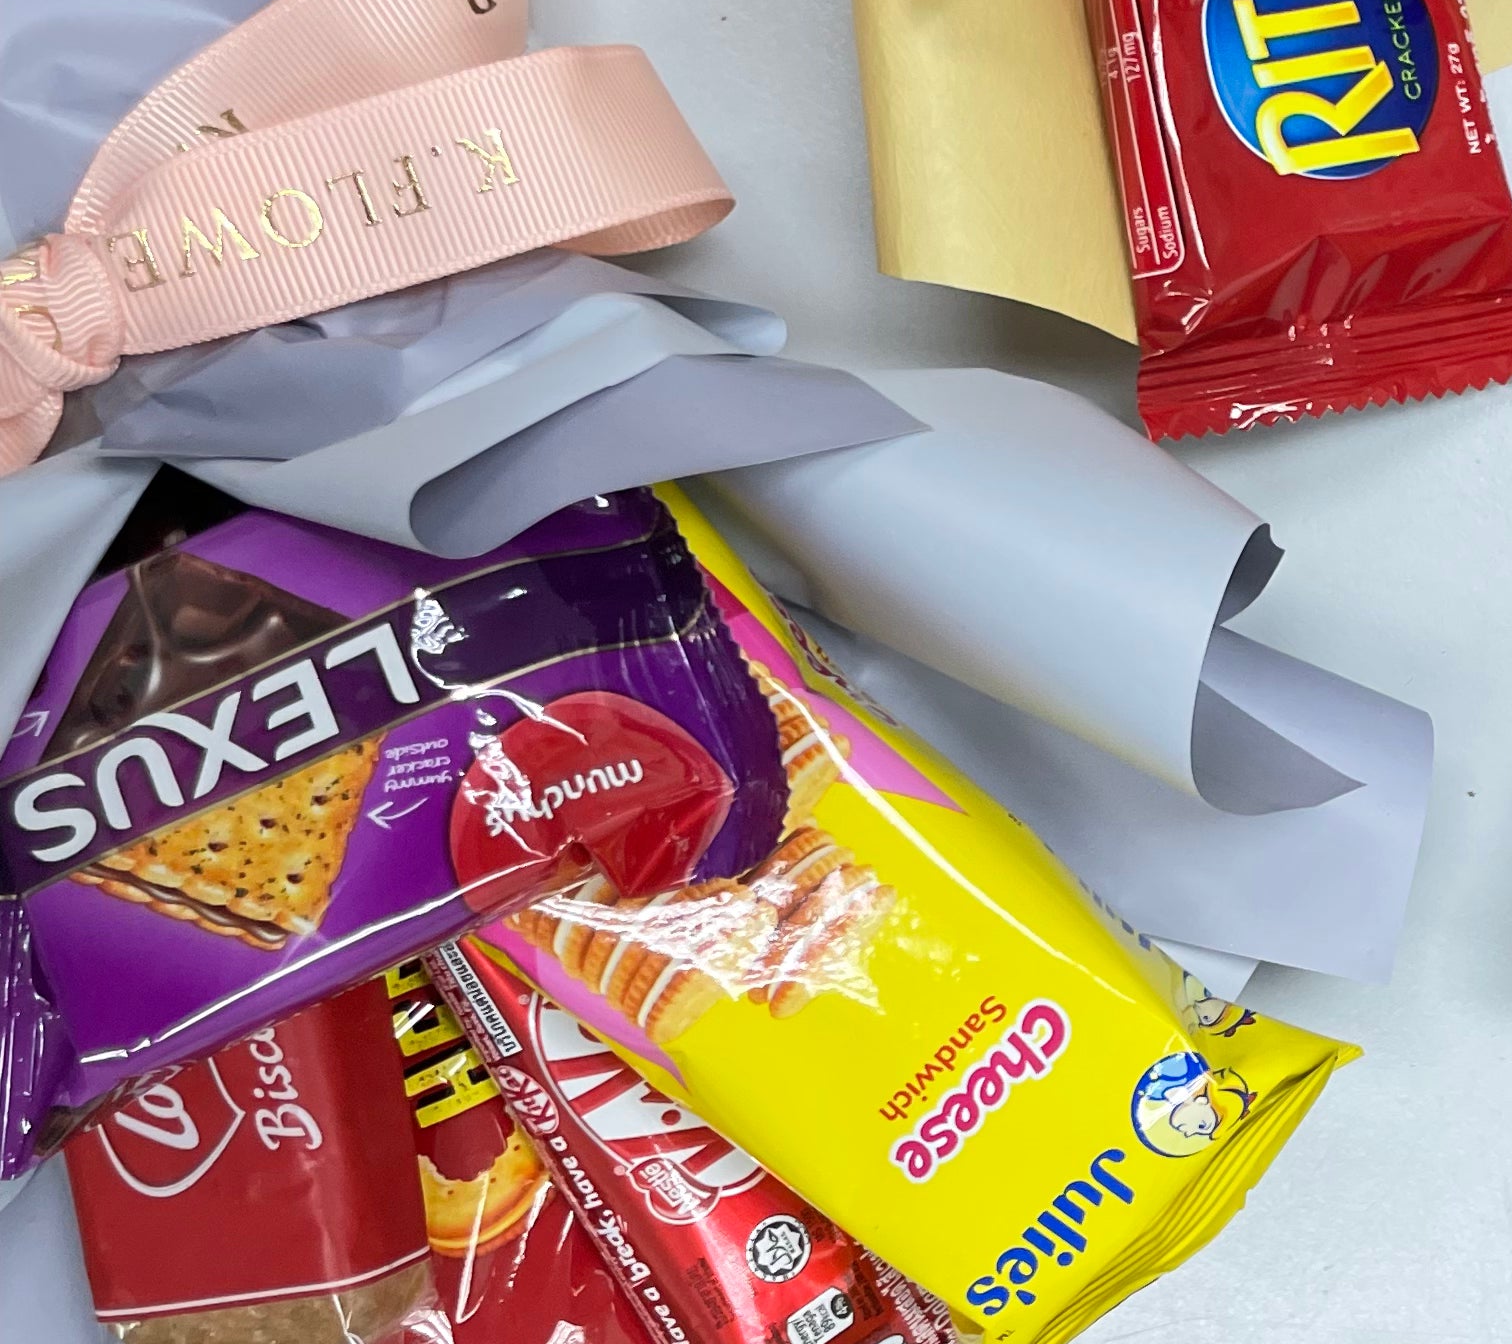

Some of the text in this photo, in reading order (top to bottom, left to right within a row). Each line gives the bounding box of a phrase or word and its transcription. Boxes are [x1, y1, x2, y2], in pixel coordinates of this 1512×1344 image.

[1446, 42, 1480, 154] NET WT: 27g
[107, 128, 521, 293] K.FLOWE
[1133, 207, 1152, 253] Sugars
[1160, 205, 1179, 259] Sodium
[13, 624, 420, 862] LEXUS
[384, 738, 448, 758] outside
[388, 755, 450, 775] cracker
[384, 770, 452, 792] yummy
[255, 1026, 323, 1150] Bisc
[878, 995, 1007, 1121] Sandwich
[895, 1002, 1067, 1178] Cheese
[547, 1133, 568, 1154] a
[557, 1150, 603, 1213] have
[588, 1204, 652, 1287] break,
[966, 1148, 1135, 1315] Julie's
[642, 1283, 661, 1303] a
[803, 1310, 824, 1344] Tenaga
